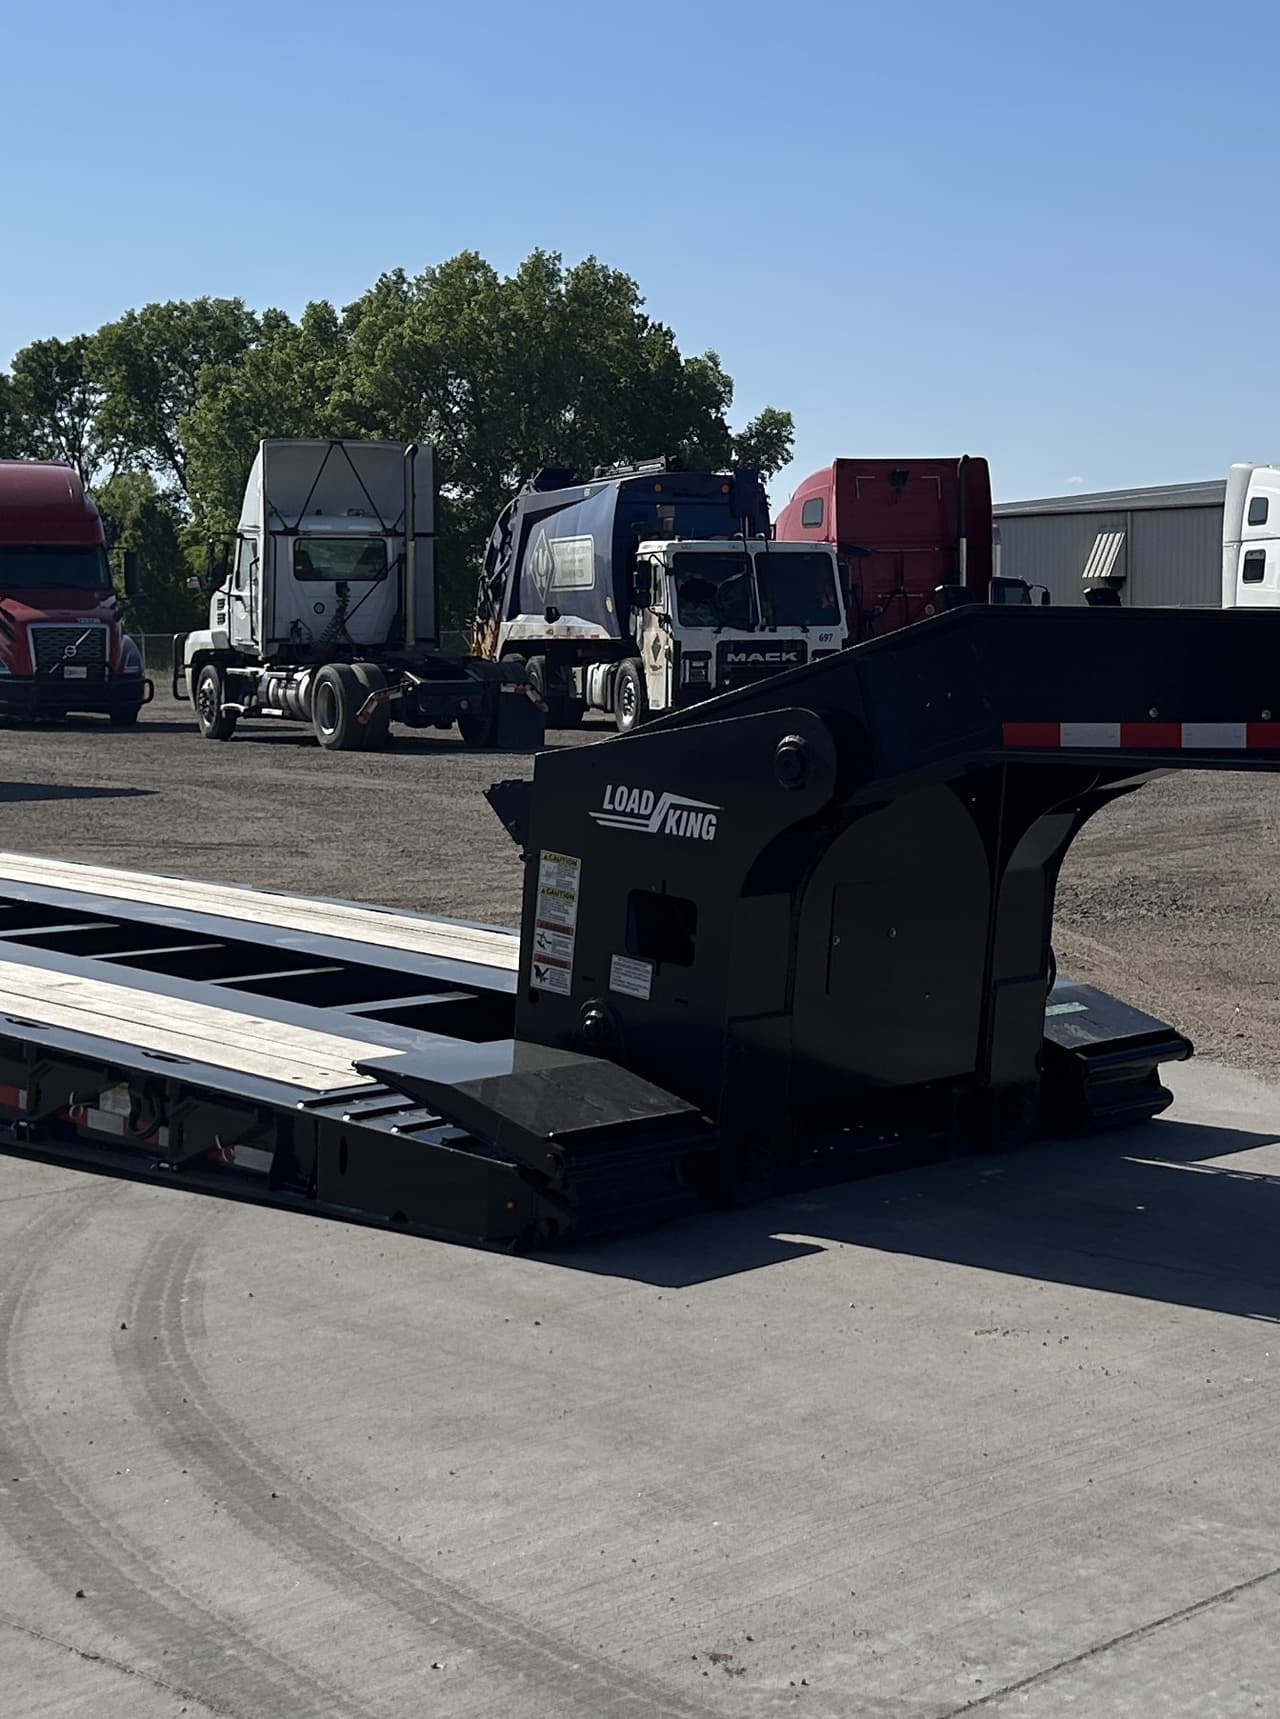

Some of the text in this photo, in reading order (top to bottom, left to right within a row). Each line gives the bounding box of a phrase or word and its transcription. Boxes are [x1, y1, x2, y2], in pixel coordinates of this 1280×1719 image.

[818, 632, 833, 642] 697
[726, 652, 798, 662] MACK
[602, 785, 717, 840] LOAD KING
[548, 853, 577, 866] CAUTION
[545, 887, 575, 900] CAUTION
